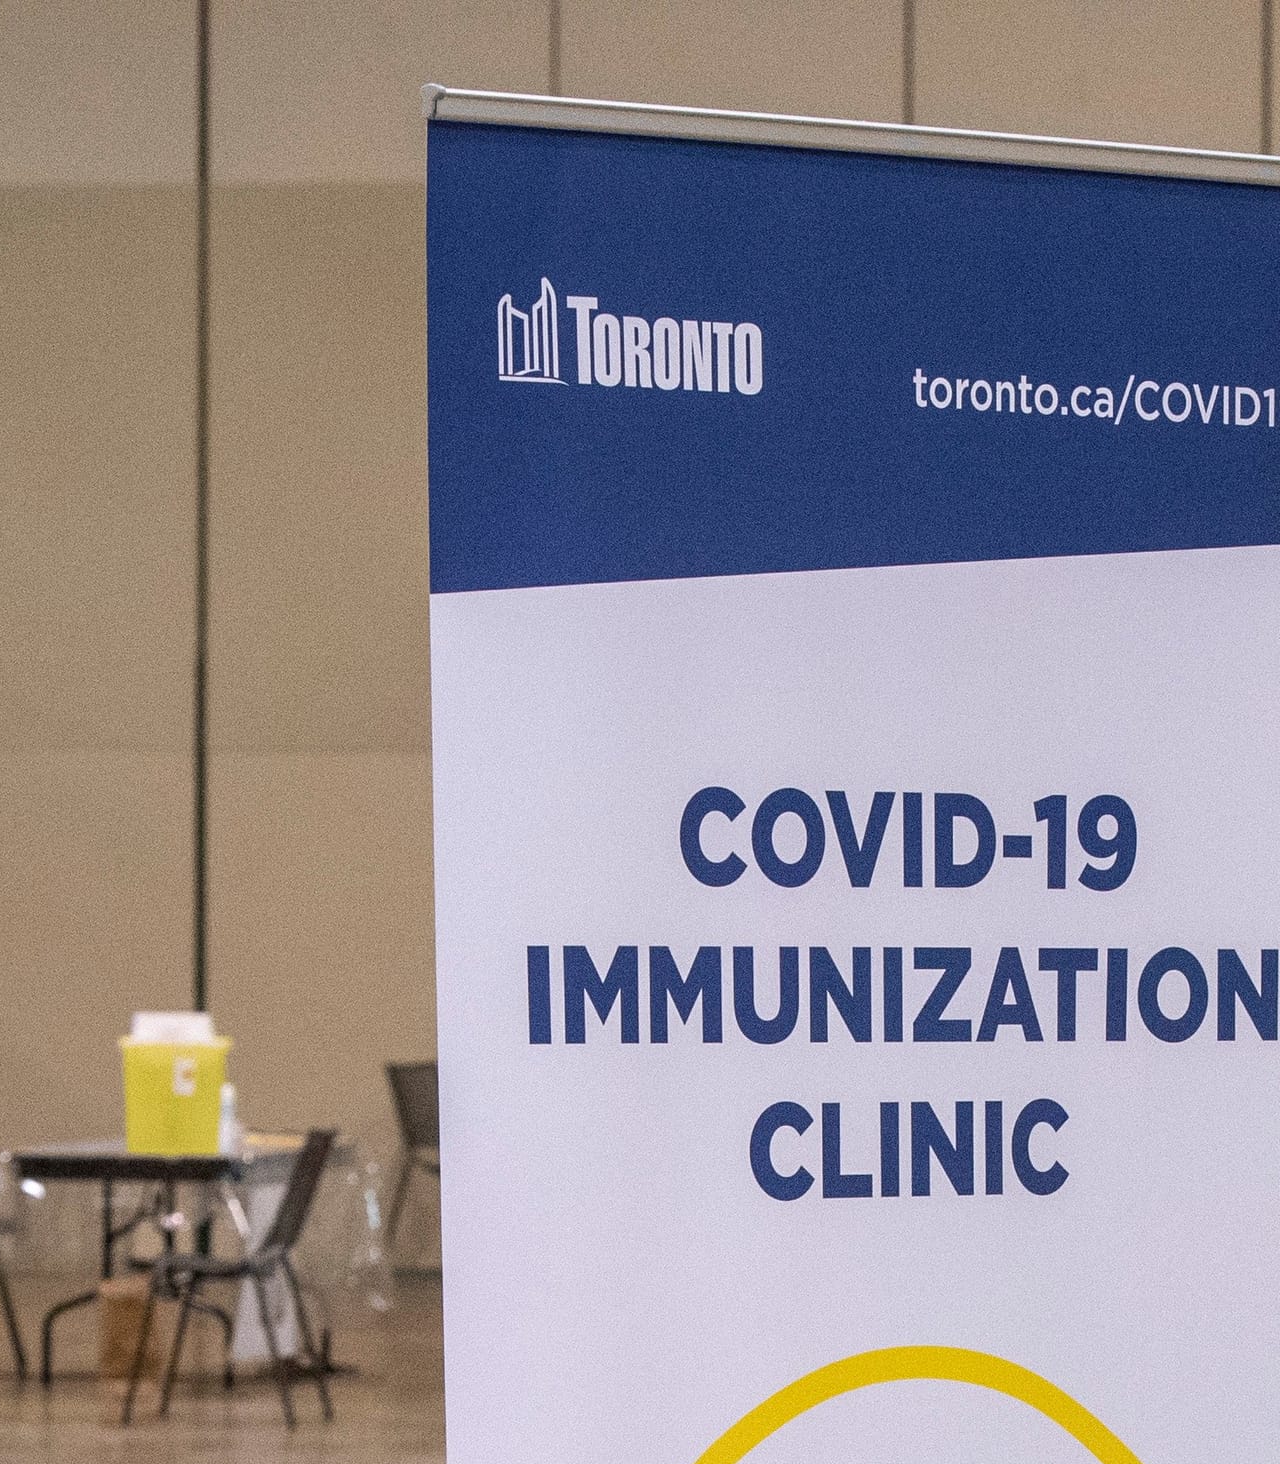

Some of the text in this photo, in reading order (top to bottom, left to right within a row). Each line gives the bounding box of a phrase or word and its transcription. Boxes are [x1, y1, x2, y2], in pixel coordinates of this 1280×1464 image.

[566, 295, 764, 396] TORONTO
[679, 786, 1138, 892] COVID-19
[527, 945, 1279, 1045] IMMUNIZATION
[749, 1098, 1070, 1202] CLINIC
